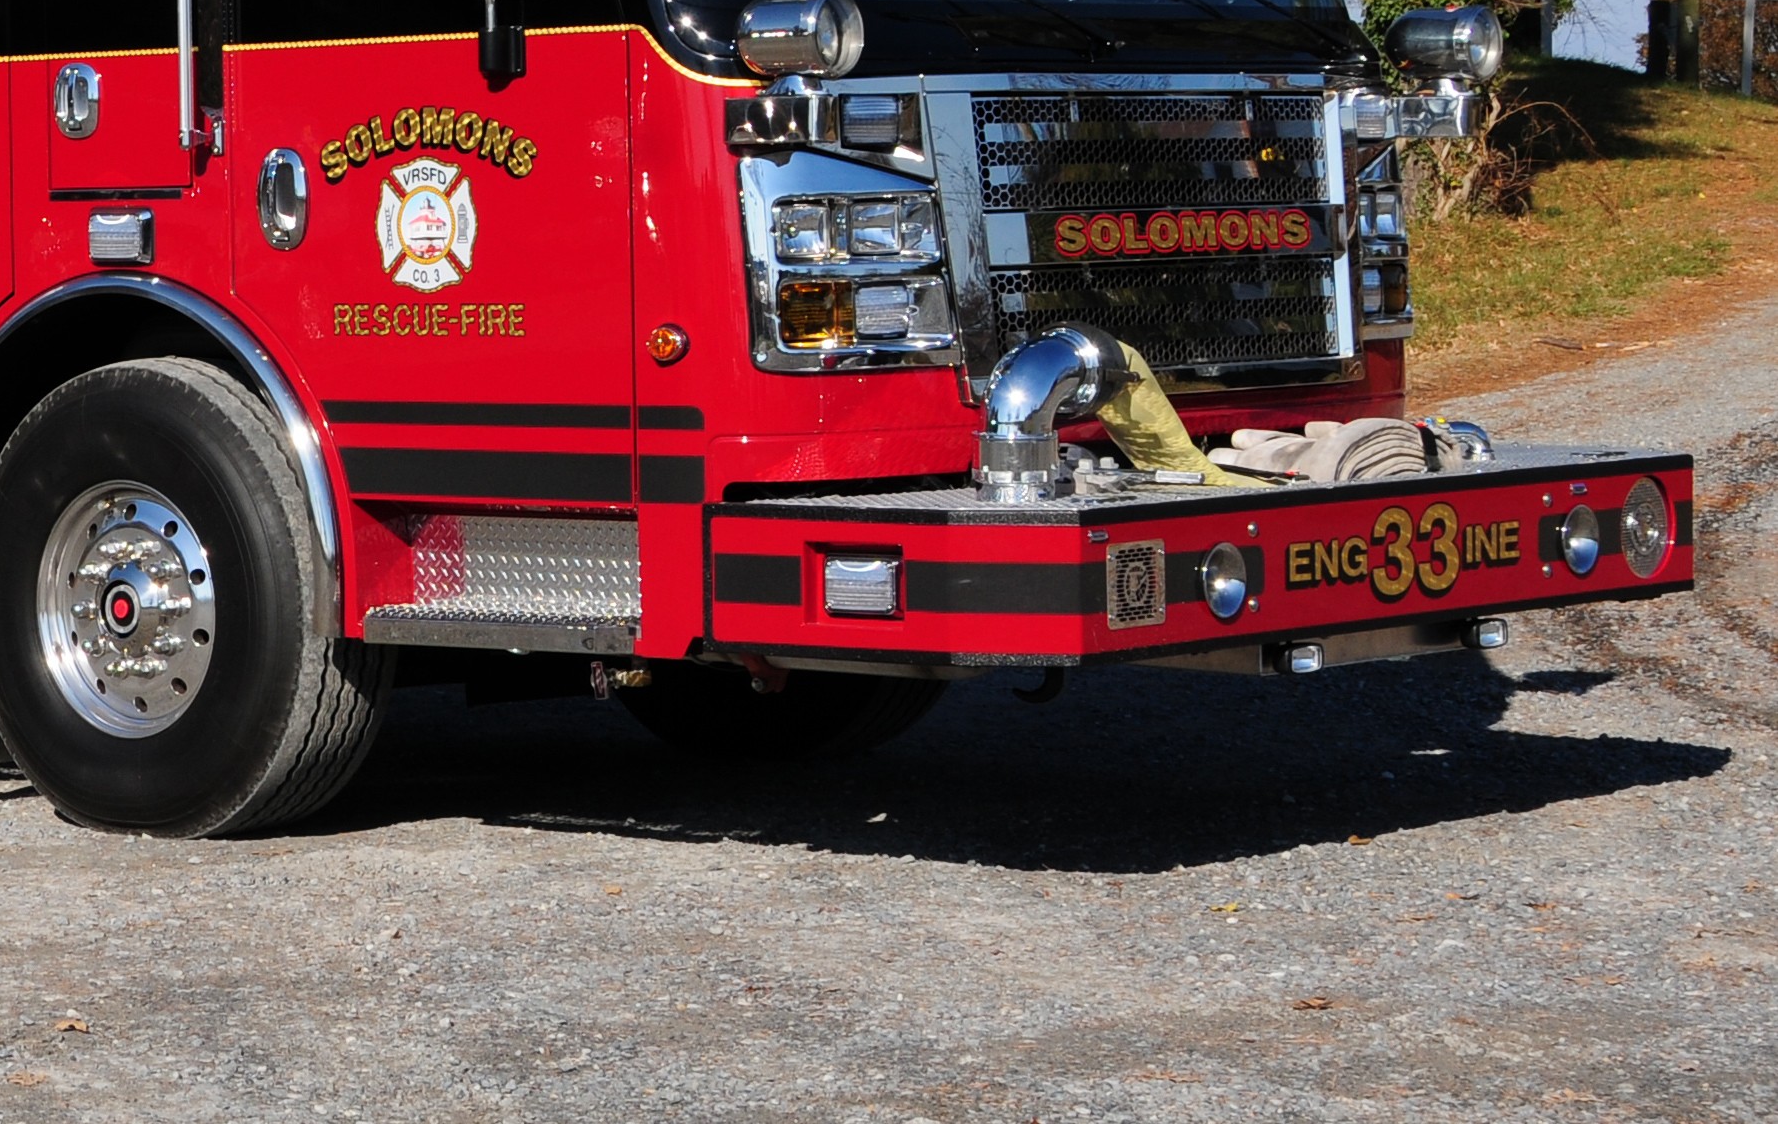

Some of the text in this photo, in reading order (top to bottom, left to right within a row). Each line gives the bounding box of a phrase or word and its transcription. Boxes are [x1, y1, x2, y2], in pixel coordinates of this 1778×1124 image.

[321, 106, 537, 182] SOLOMONS
[403, 166, 447, 186] VRSFD
[1056, 209, 1312, 256] SOLOMONS
[412, 268, 441, 284] CO. 3
[333, 303, 526, 336] RESCUE-FIRE
[1287, 502, 1521, 601] ENG 33 INE
